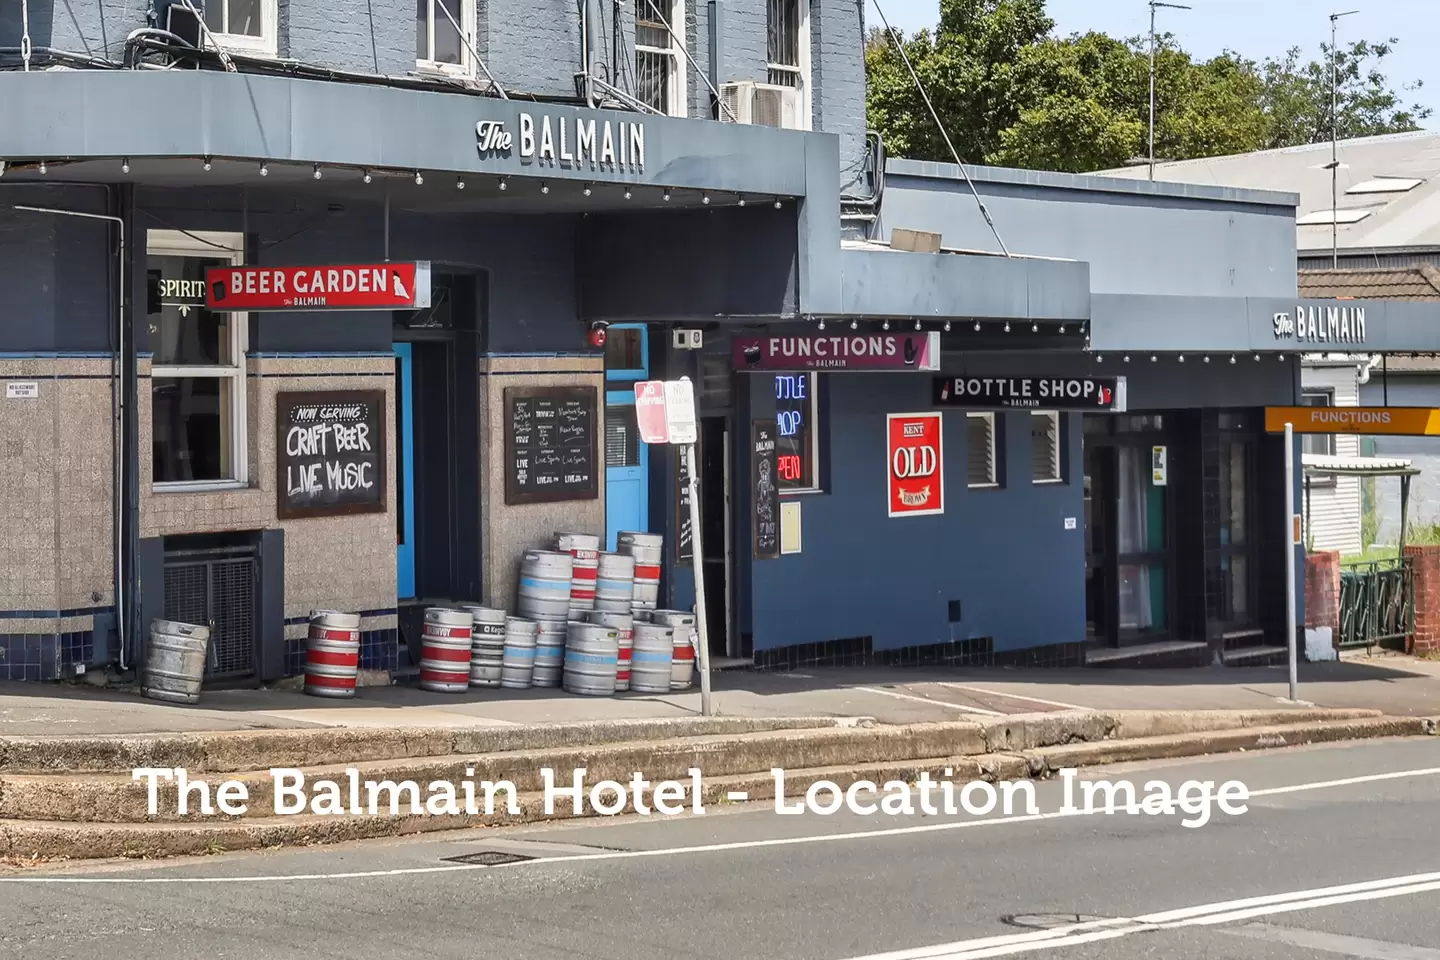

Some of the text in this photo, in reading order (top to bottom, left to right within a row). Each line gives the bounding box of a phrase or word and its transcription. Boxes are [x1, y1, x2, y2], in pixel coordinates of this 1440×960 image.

[476, 112, 645, 169] The BALMAIN
[158, 279, 206, 298] SPIRIT
[230, 268, 388, 294] BEER GARDEN
[293, 296, 326, 306] BALMAIN
[1273, 305, 1366, 341] The BALMAIN
[769, 336, 896, 357] FUNCTIONS
[815, 359, 846, 368] BALMAIN
[776, 375, 806, 399] TTLE
[954, 378, 1095, 398] BOTTLE SHOP
[296, 406, 361, 420] NOW SERVING
[1010, 399, 1040, 407] BALMAIN
[1311, 411, 1391, 424] FUNCTIONS
[286, 422, 371, 456] CRAFT BEER
[903, 425, 924, 435] KENT
[516, 458, 528, 468] LIVE
[777, 456, 802, 480] PEN
[893, 445, 937, 478] OLD
[287, 460, 374, 496] LIVE MUSIC
[903, 493, 927, 505] BROWN
